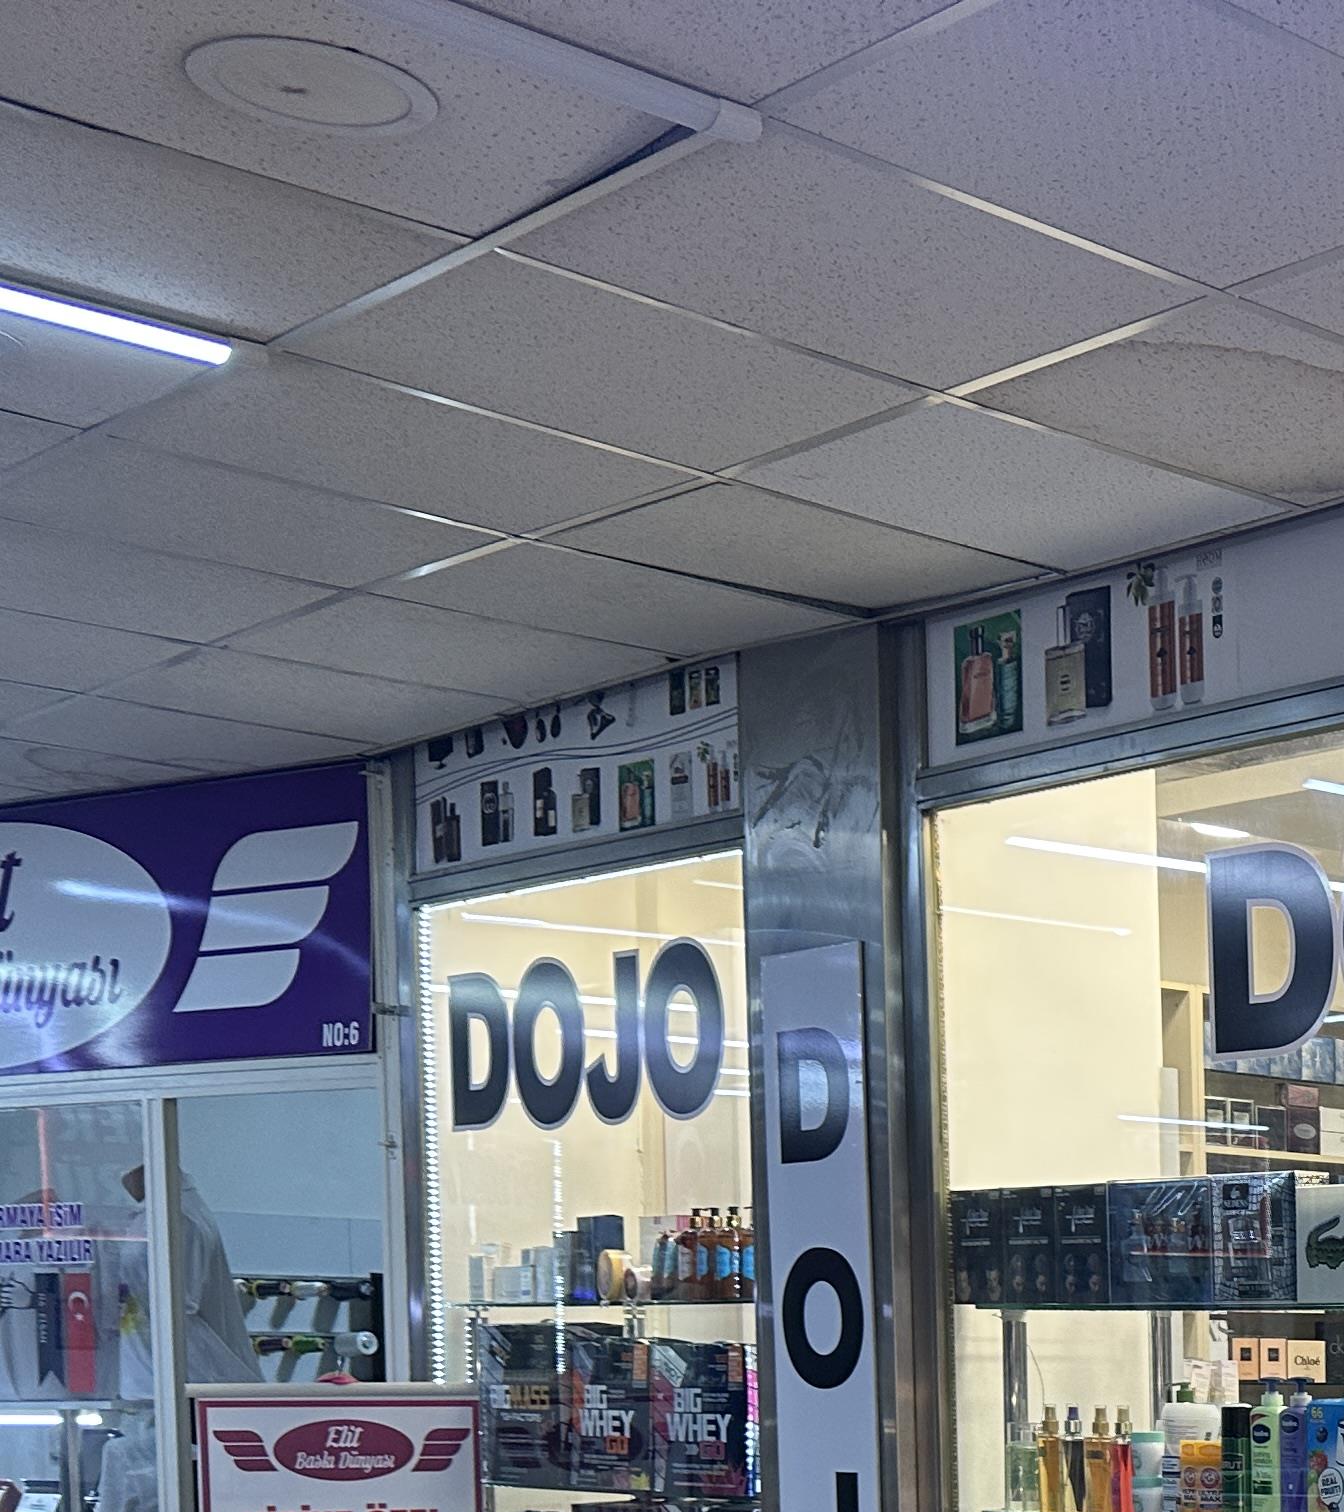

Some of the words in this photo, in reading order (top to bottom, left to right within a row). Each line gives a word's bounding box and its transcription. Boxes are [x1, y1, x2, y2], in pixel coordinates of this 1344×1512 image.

[322, 1022, 359, 1047] NO:6
[447, 936, 724, 1132] DOJO
[1294, 1354, 1321, 1367] Chloé
[580, 1410, 634, 1438] WHEY
[666, 1413, 731, 1442] WHEY
